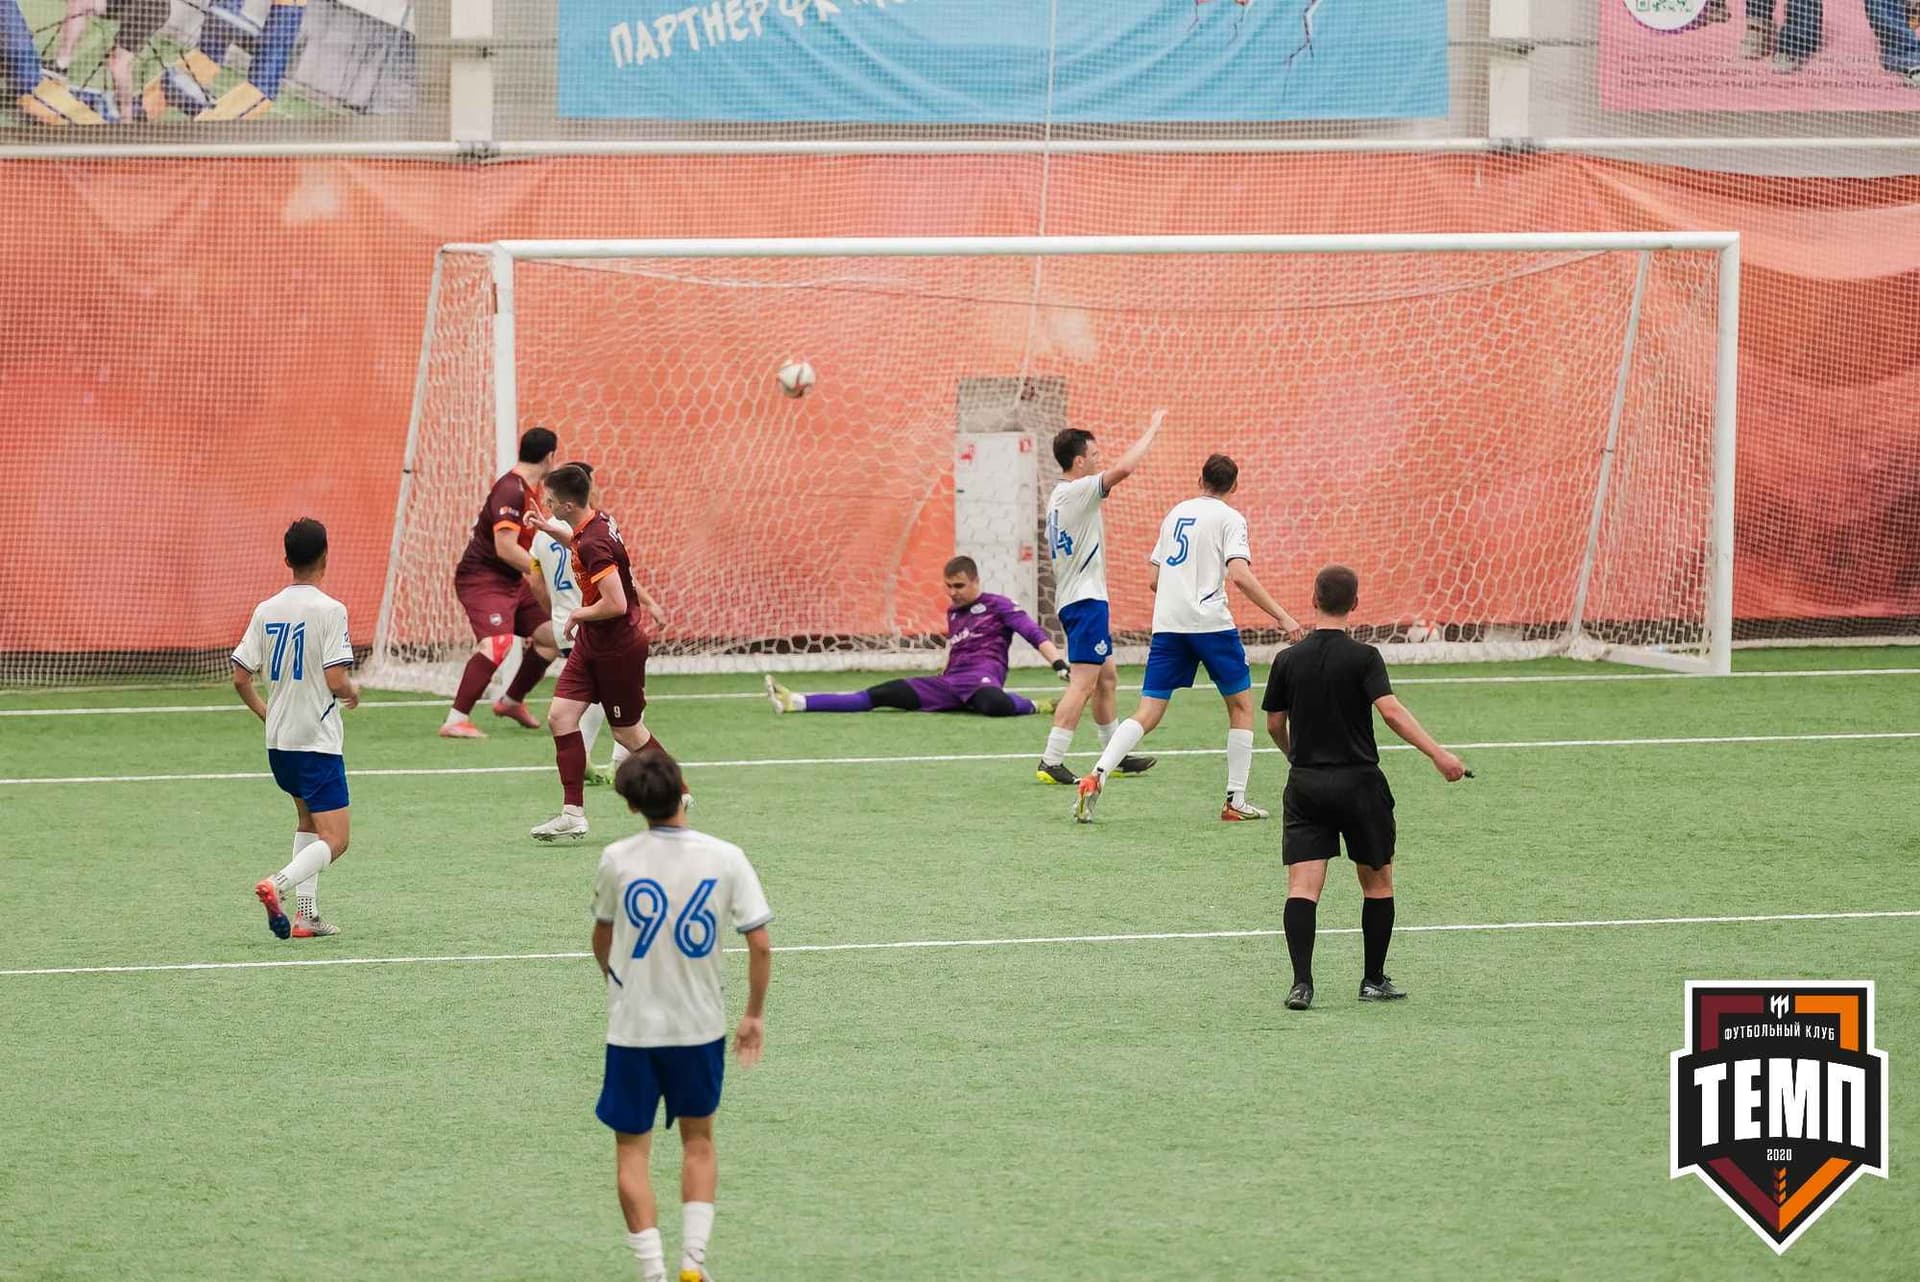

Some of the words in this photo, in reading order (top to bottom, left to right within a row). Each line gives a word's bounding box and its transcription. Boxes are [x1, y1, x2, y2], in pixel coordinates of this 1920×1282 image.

[610, 0, 769, 68] ПАРТНЕР
[1166, 517, 1197, 567] 5
[264, 621, 306, 681] 71
[613, 705, 621, 719] 9
[624, 878, 718, 959] 96
